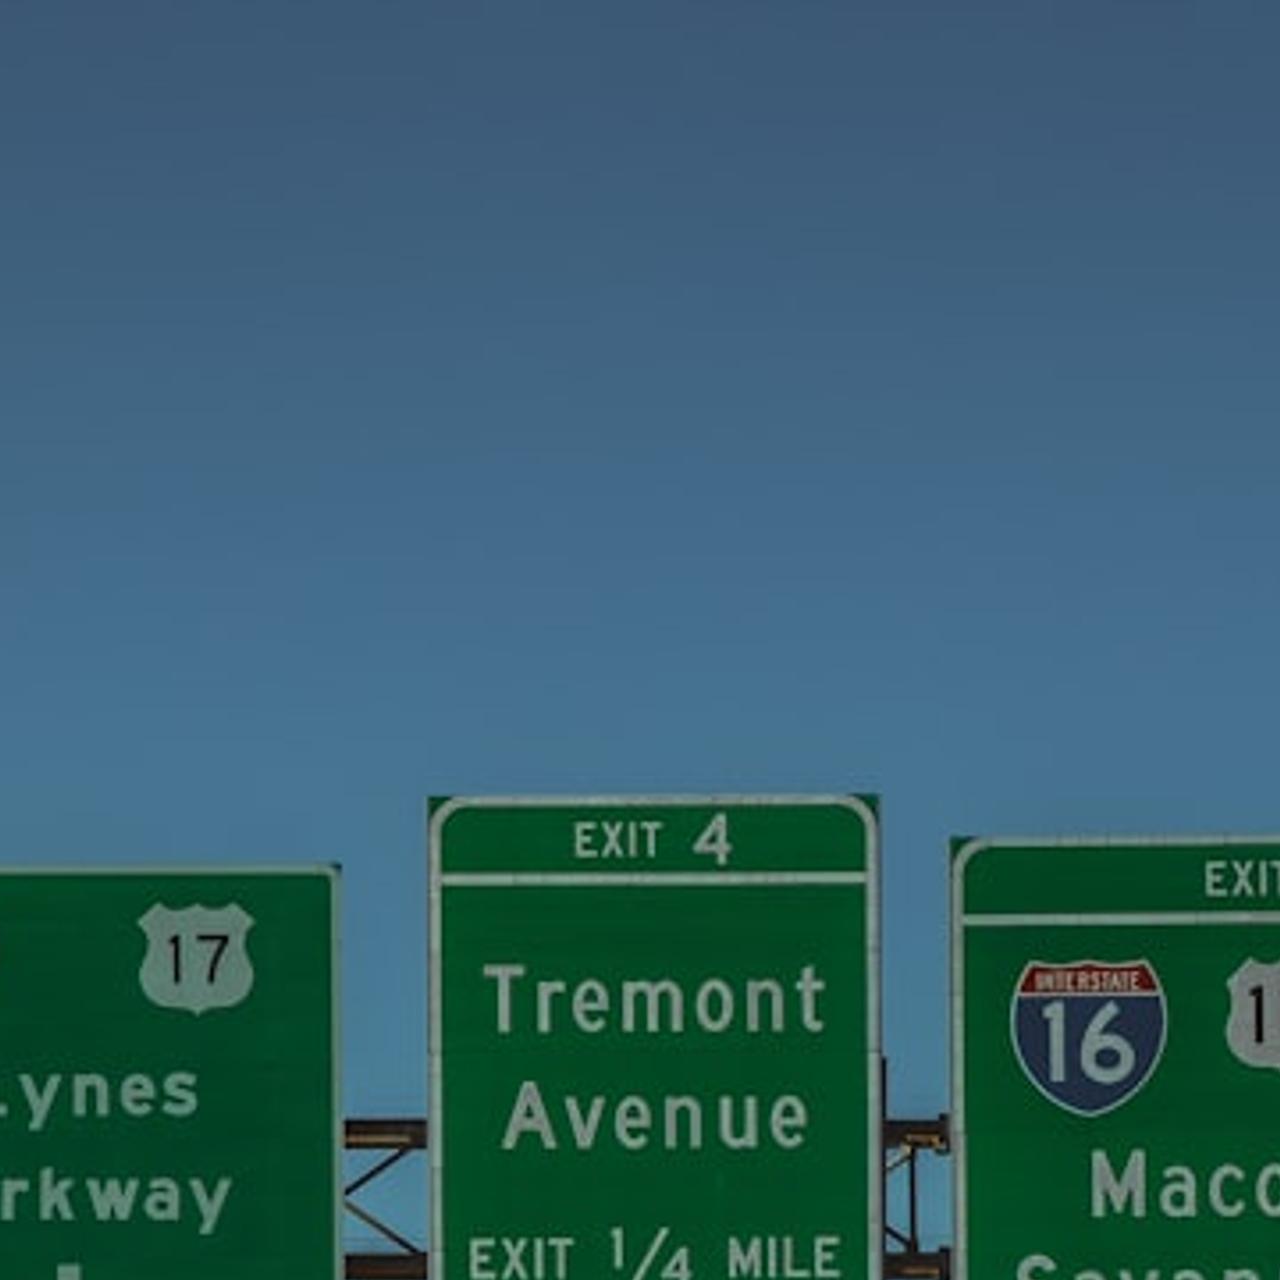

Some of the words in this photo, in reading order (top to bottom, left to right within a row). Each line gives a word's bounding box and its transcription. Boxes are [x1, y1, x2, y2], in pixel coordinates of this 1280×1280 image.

[574, 822, 663, 858] EXIT
[693, 813, 732, 866] 4
[167, 934, 230, 985] 17
[1033, 969, 1141, 992] INTERSTATE
[483, 964, 826, 1033] Tremont
[1041, 999, 1137, 1086] 16
[501, 1080, 808, 1150] Avenue
[468, 1237, 575, 1280] EXIT
[727, 1235, 842, 1278] MILE
